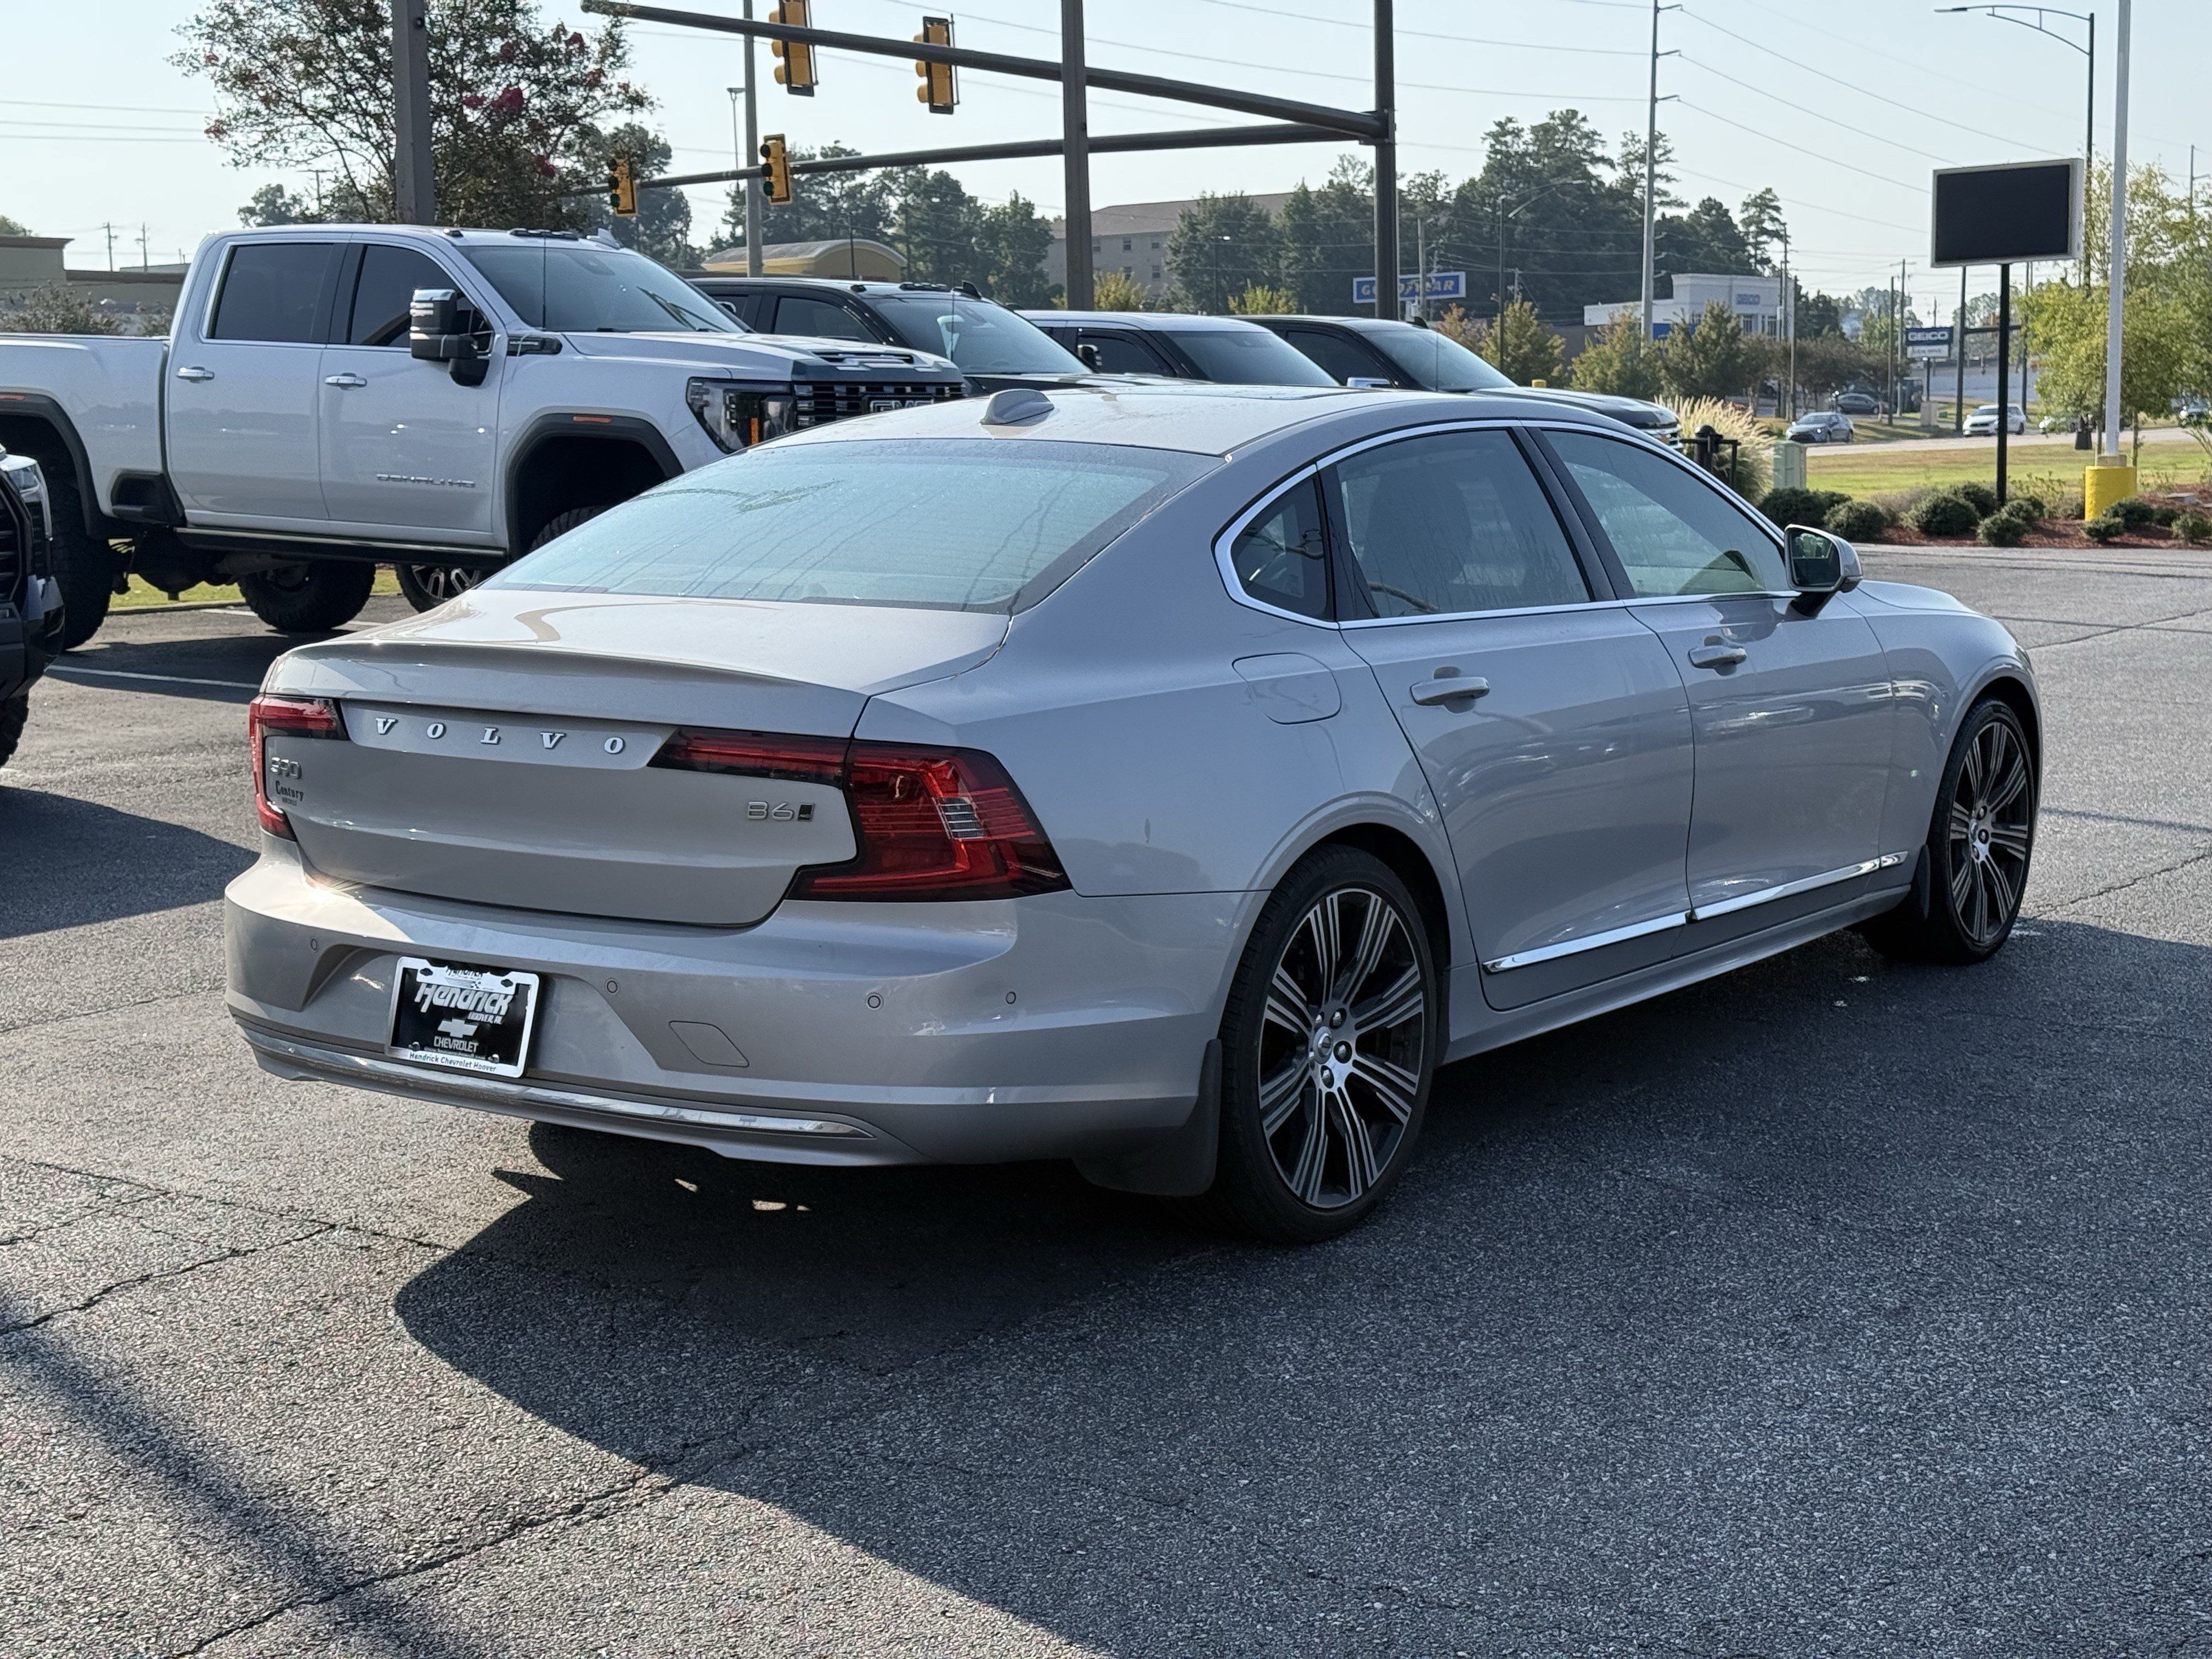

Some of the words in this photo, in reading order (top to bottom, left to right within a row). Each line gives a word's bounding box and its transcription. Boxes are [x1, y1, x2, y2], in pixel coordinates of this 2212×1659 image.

[1908, 331, 1949, 341] GEICO
[375, 718, 624, 754] VOLVO
[275, 780, 303, 802] Century
[747, 801, 793, 820] B6
[414, 983, 514, 1015] Hendrick
[433, 1035, 479, 1053] CHEVROLET
[409, 1052, 439, 1063] Hendrick
[441, 1056, 472, 1068] Chevrolet
